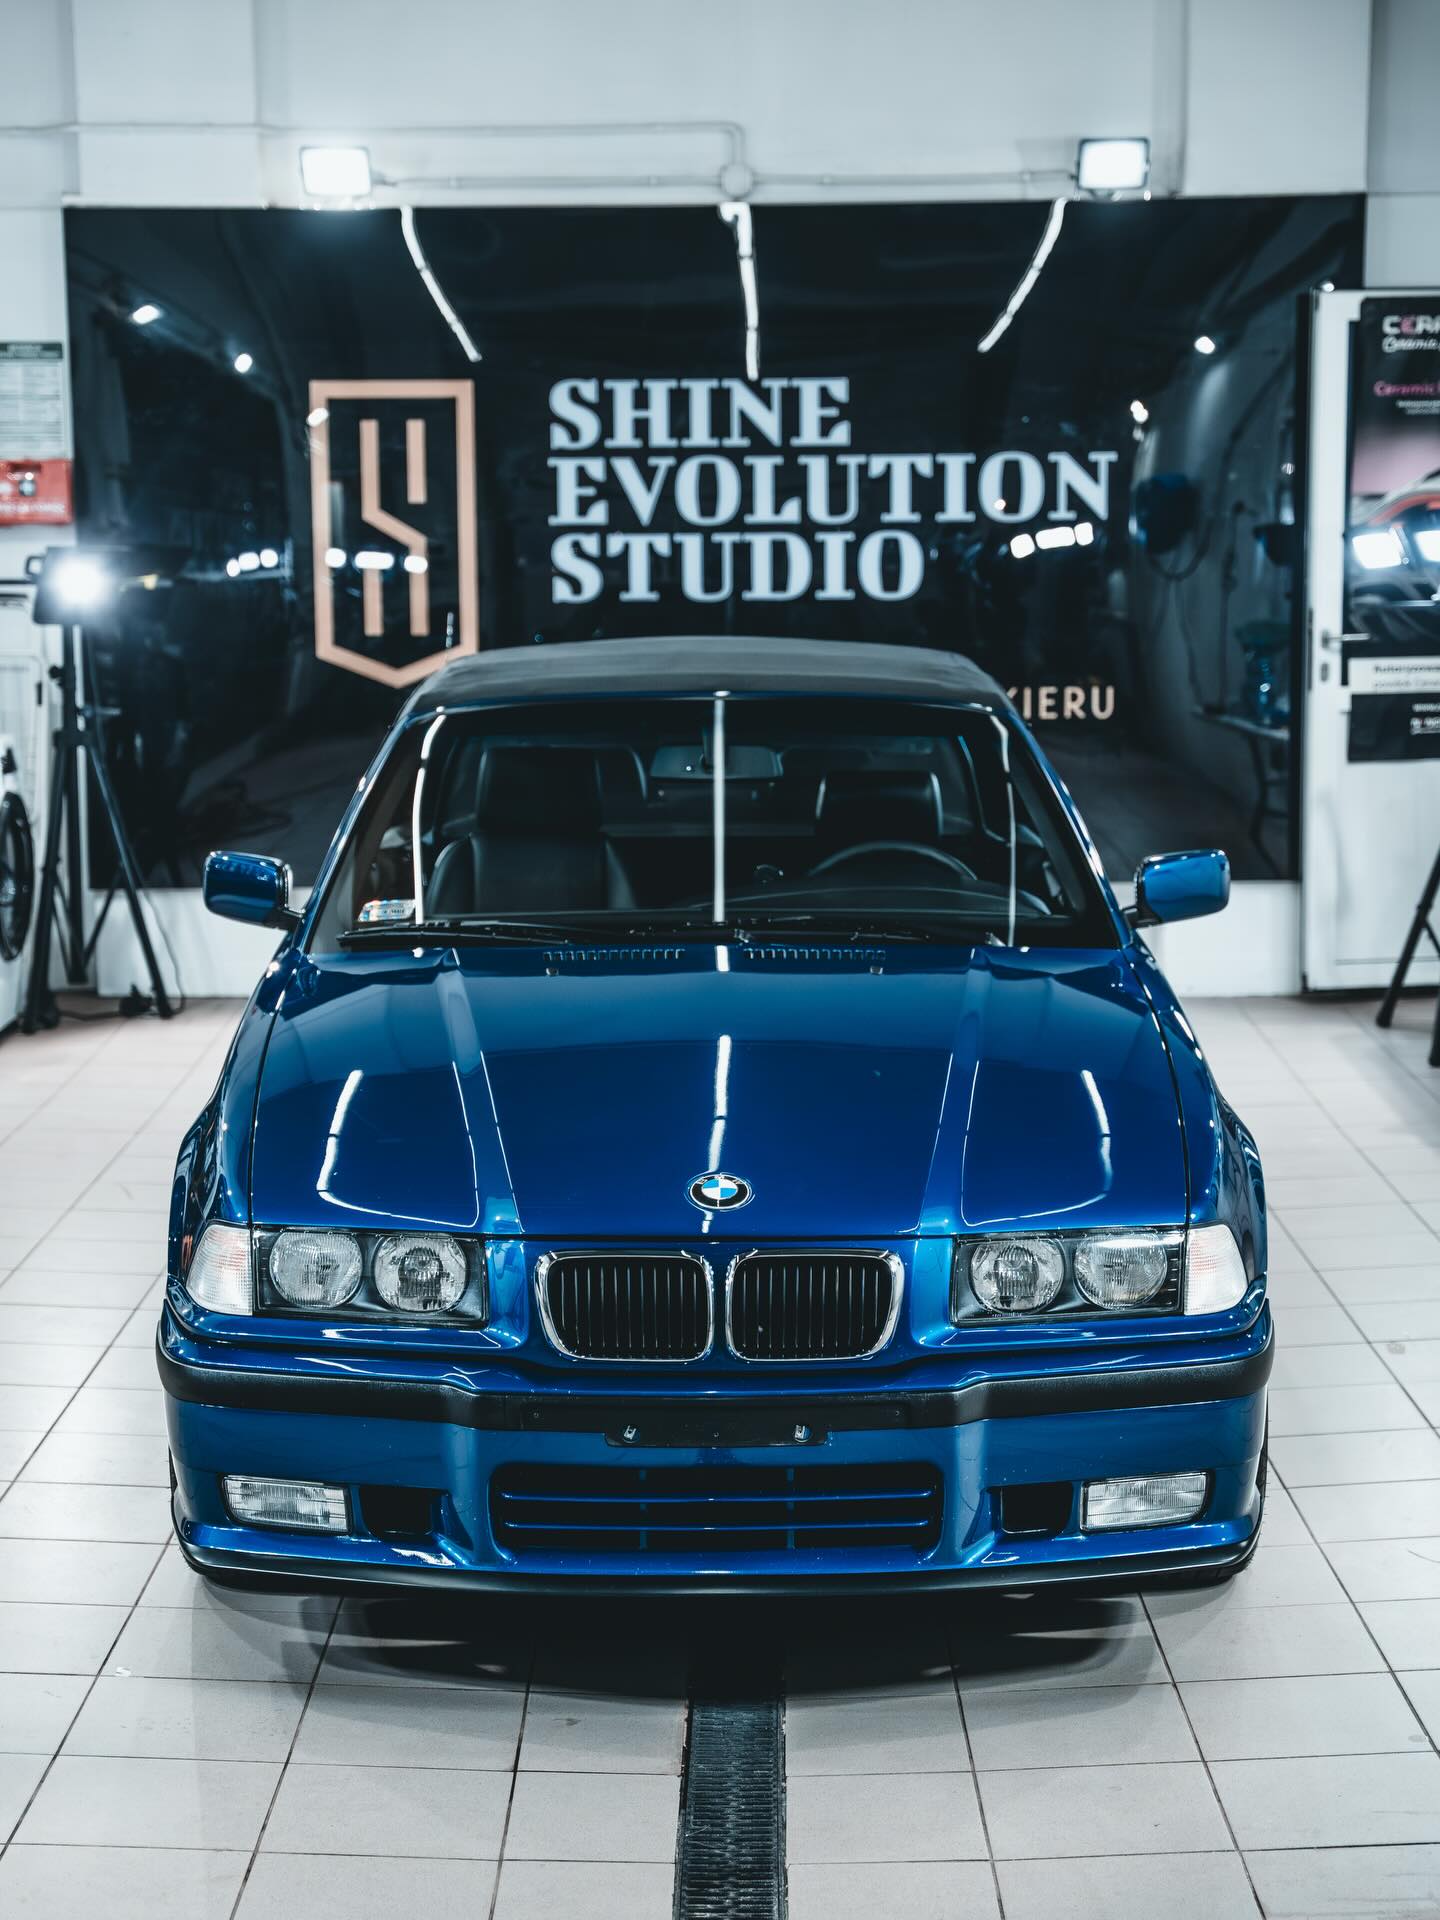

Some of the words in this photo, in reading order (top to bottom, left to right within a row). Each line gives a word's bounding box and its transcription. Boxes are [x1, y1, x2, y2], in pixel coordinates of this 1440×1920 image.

[549, 378, 851, 449] SHINE
[547, 451, 1119, 526] EVOLUTION
[551, 530, 924, 603] STUDIO
[1006, 686, 1115, 720] IERU
